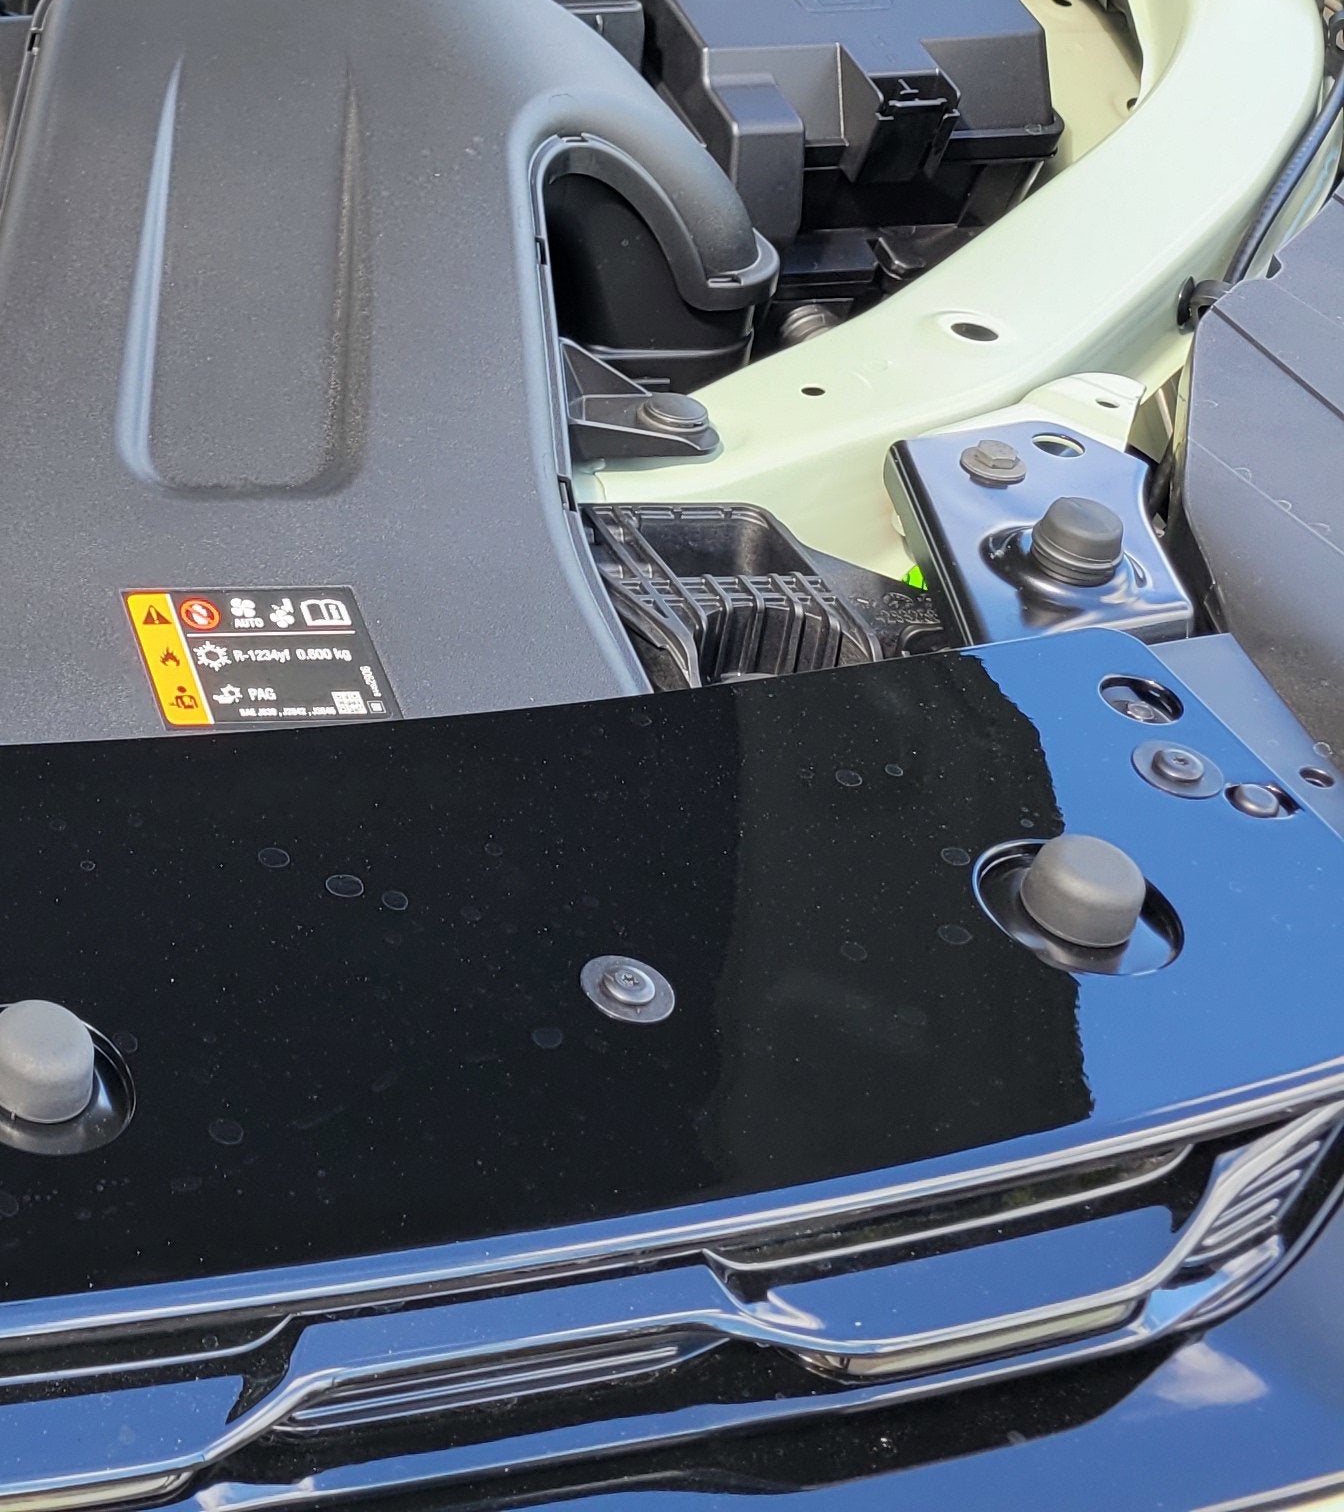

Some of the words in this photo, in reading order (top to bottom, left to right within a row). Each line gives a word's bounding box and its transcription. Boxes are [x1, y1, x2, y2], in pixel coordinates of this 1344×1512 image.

[234, 617, 265, 629] AUTO
[333, 647, 353, 662] kg
[247, 687, 277, 701] PAG
